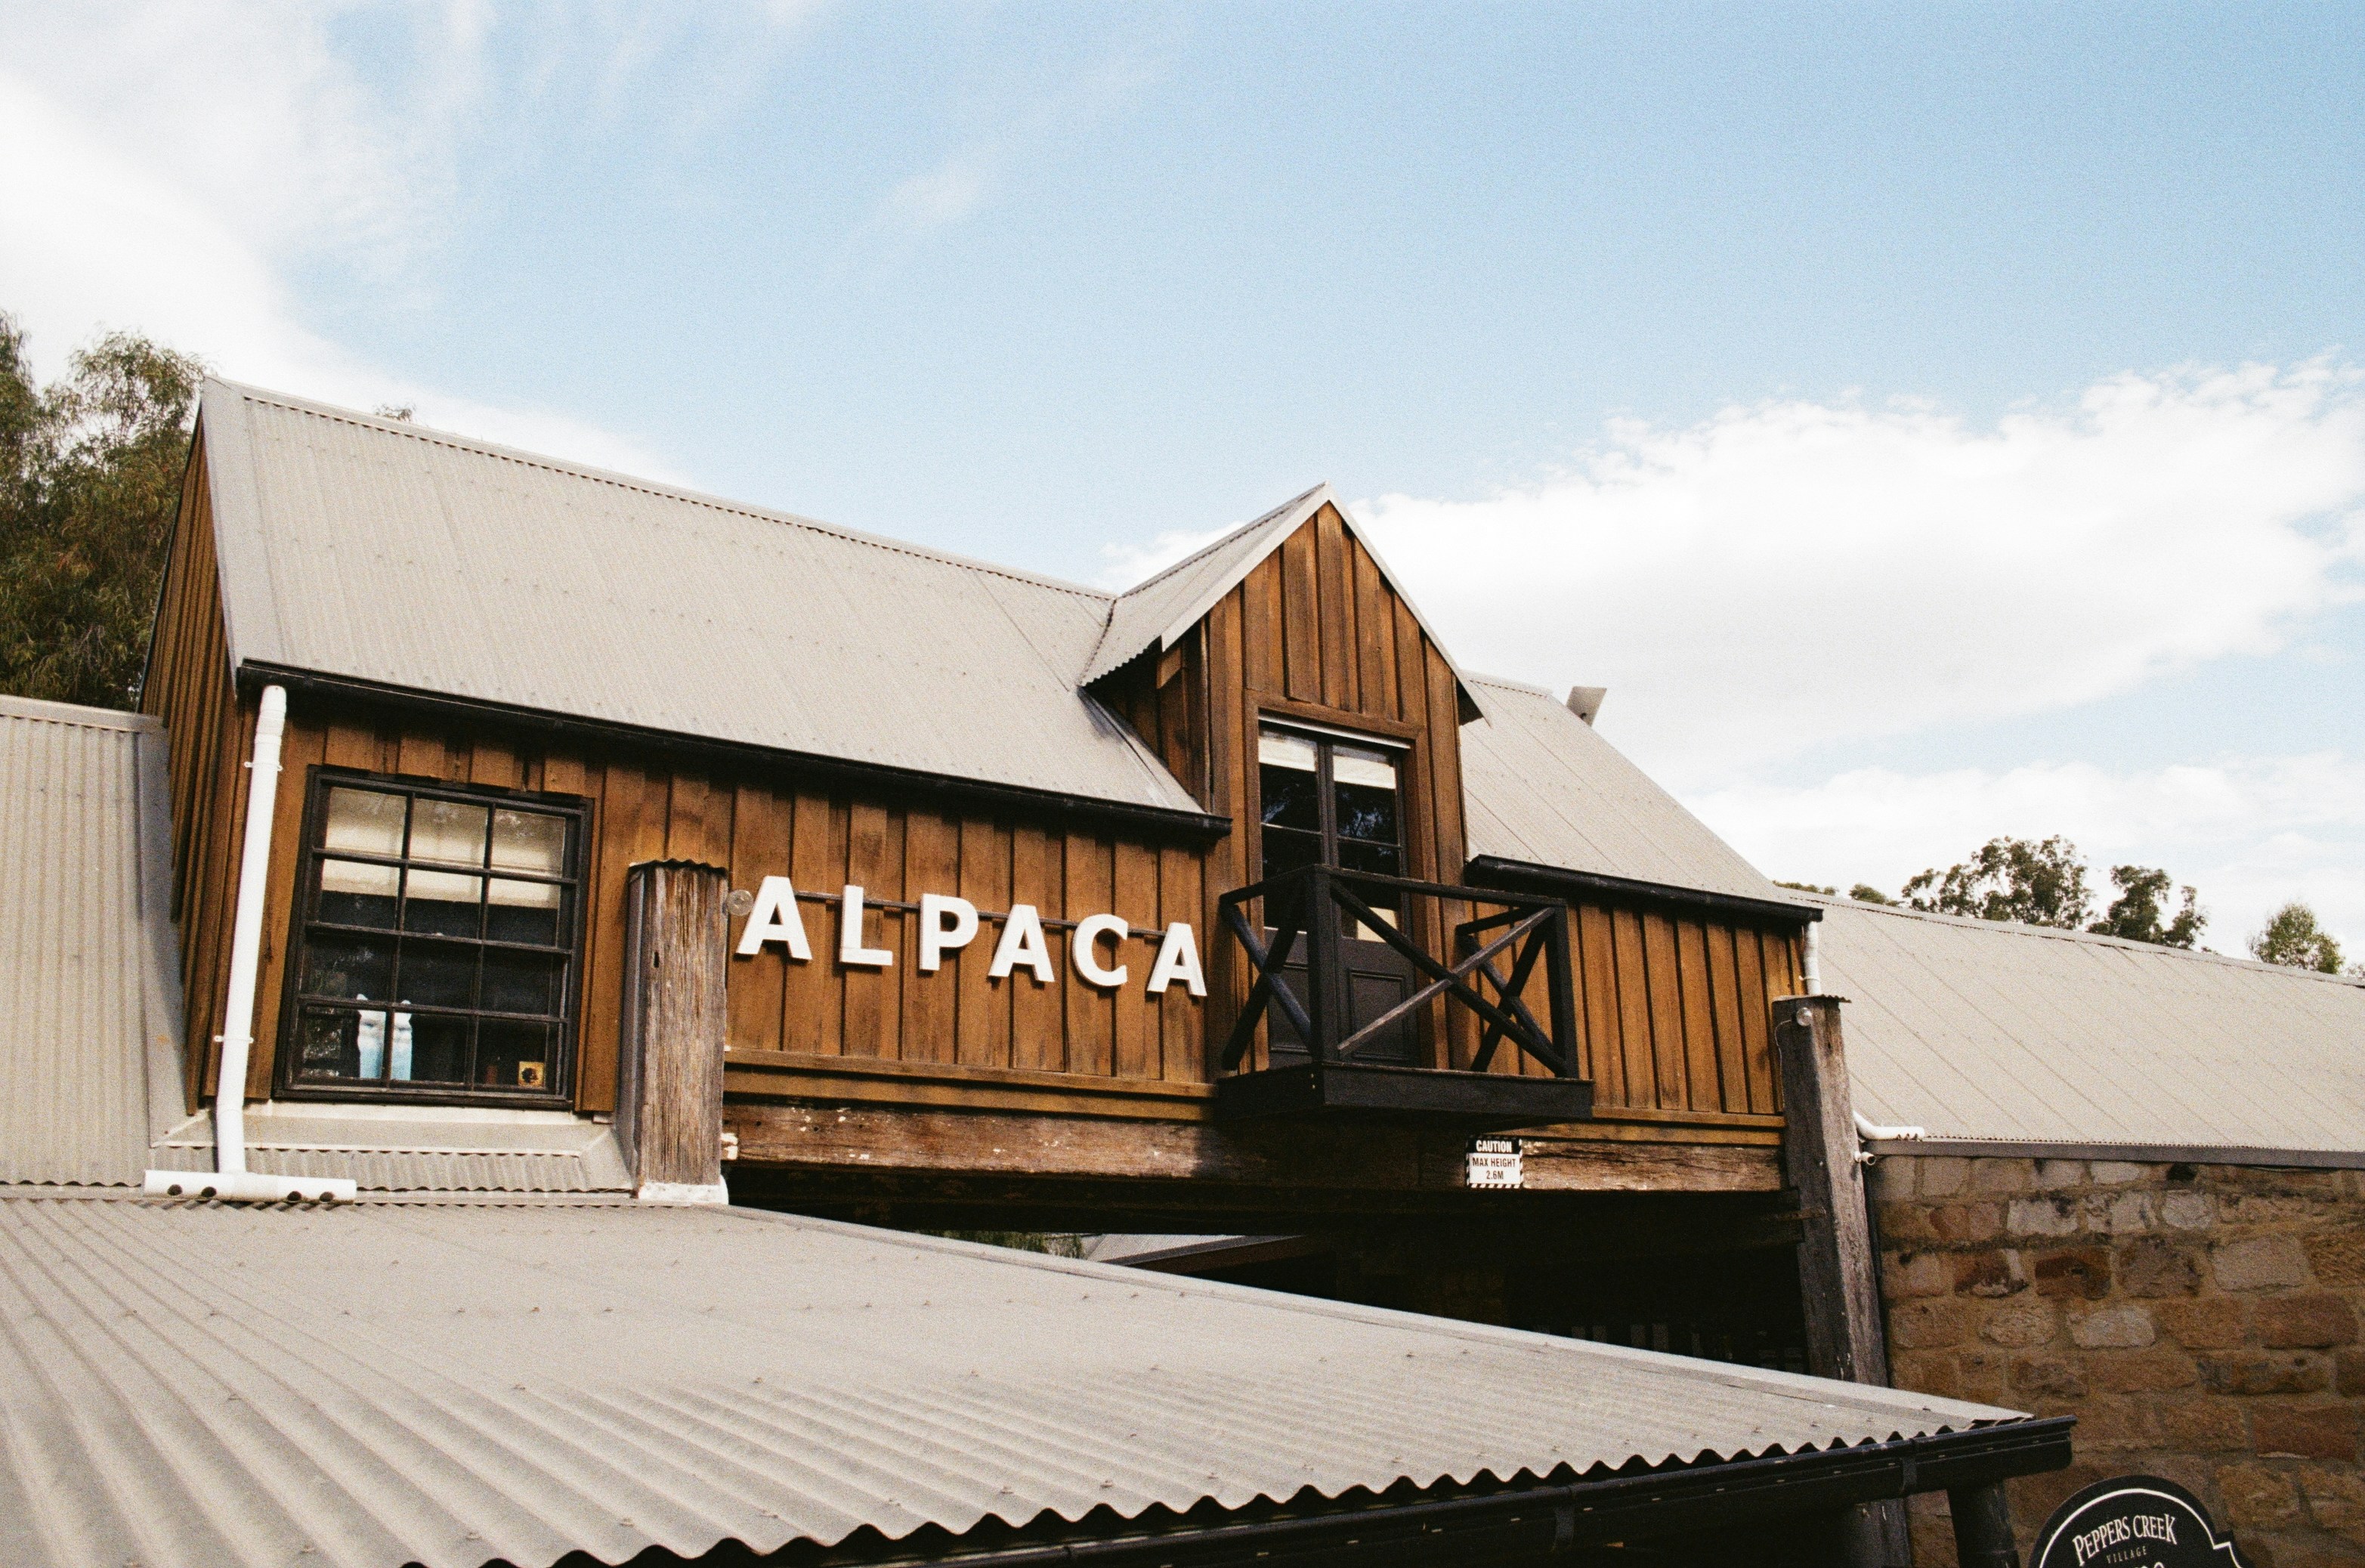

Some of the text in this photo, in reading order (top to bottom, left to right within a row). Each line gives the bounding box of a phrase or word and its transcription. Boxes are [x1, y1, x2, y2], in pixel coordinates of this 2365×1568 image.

[735, 875, 1208, 997] ALPACA
[1476, 1140, 1512, 1152] CAUTION
[1472, 1157, 1516, 1167] MAX HEIGHT
[1486, 1170, 1504, 1180] 2.6M
[2072, 1513, 2177, 1566] PEPPERS CREEK
[2106, 1545, 2147, 1563] VILLAGE
